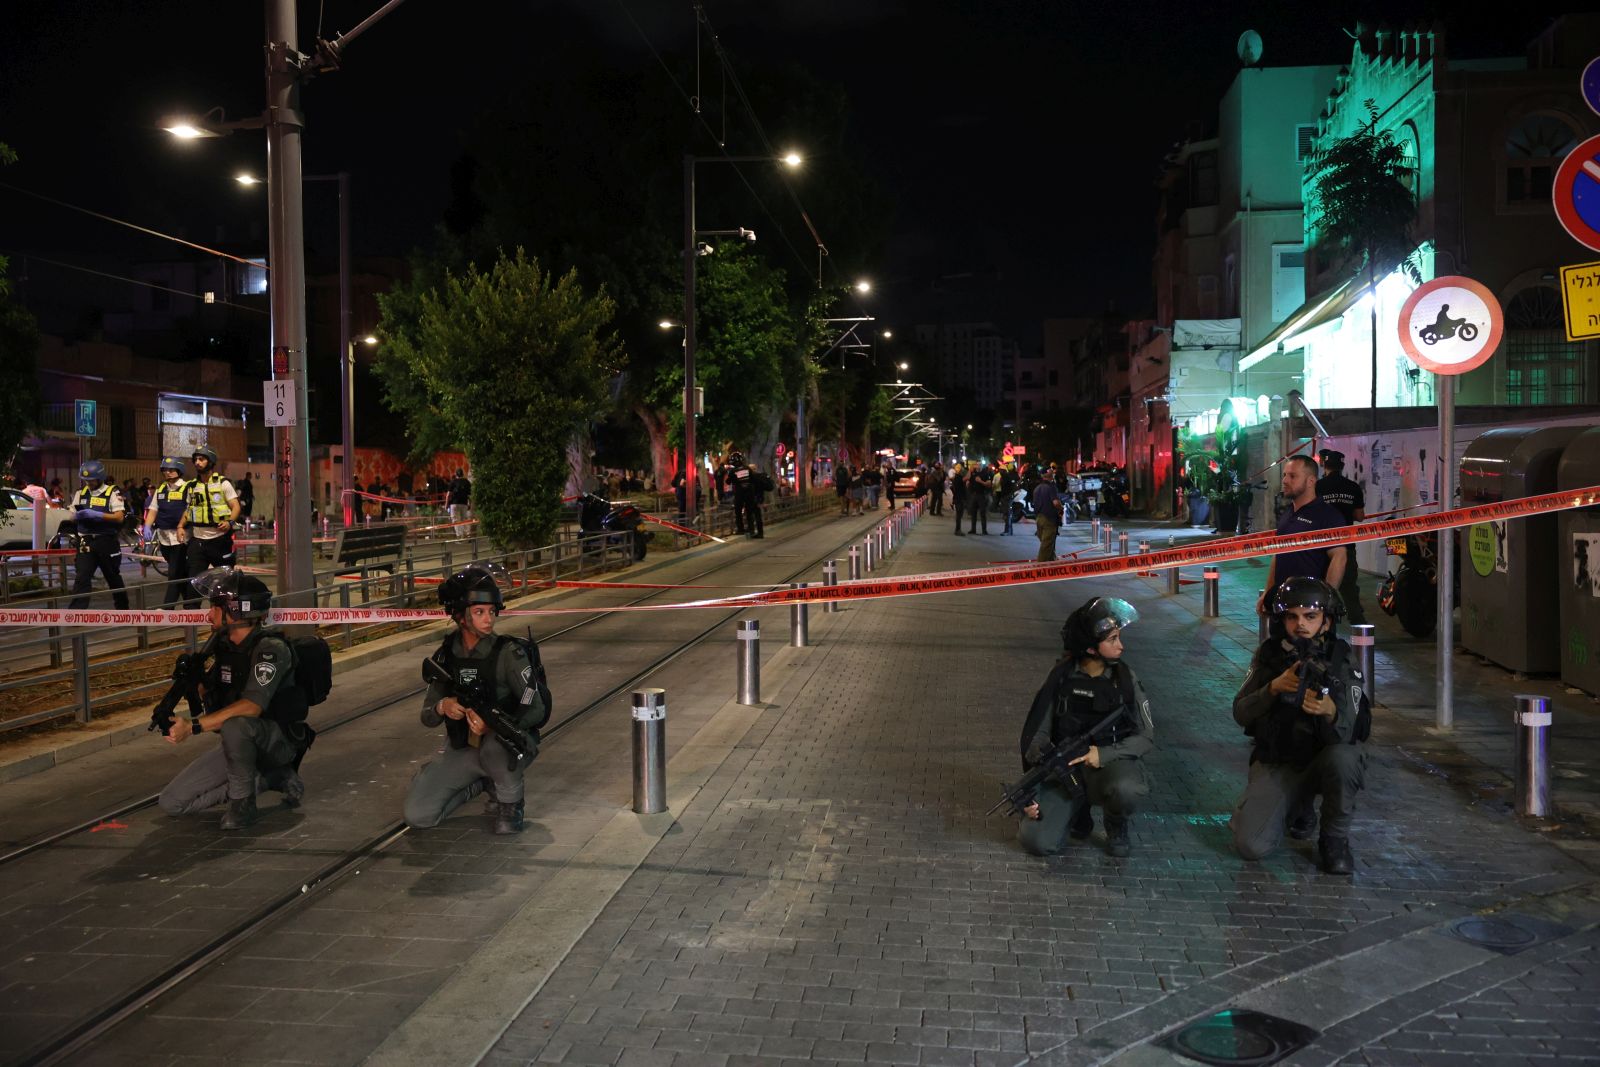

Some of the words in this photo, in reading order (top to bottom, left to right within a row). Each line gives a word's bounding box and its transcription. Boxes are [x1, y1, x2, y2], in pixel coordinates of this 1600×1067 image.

[273, 383, 285, 398] 11
[276, 402, 284, 417] 6
[9, 612, 28, 622] מעבר
[29, 613, 38, 624] אין
[39, 611, 60, 622] ישראל
[74, 613, 100, 623] משטרת
[112, 614, 131, 623] מעבר
[131, 614, 141, 624] אין
[141, 612, 164, 623] ישראל
[177, 613, 204, 624] משטרת
[282, 611, 309, 622] משטרת
[320, 610, 340, 621] מעבר
[340, 610, 349, 621] אין
[349, 609, 372, 620] ישראל
